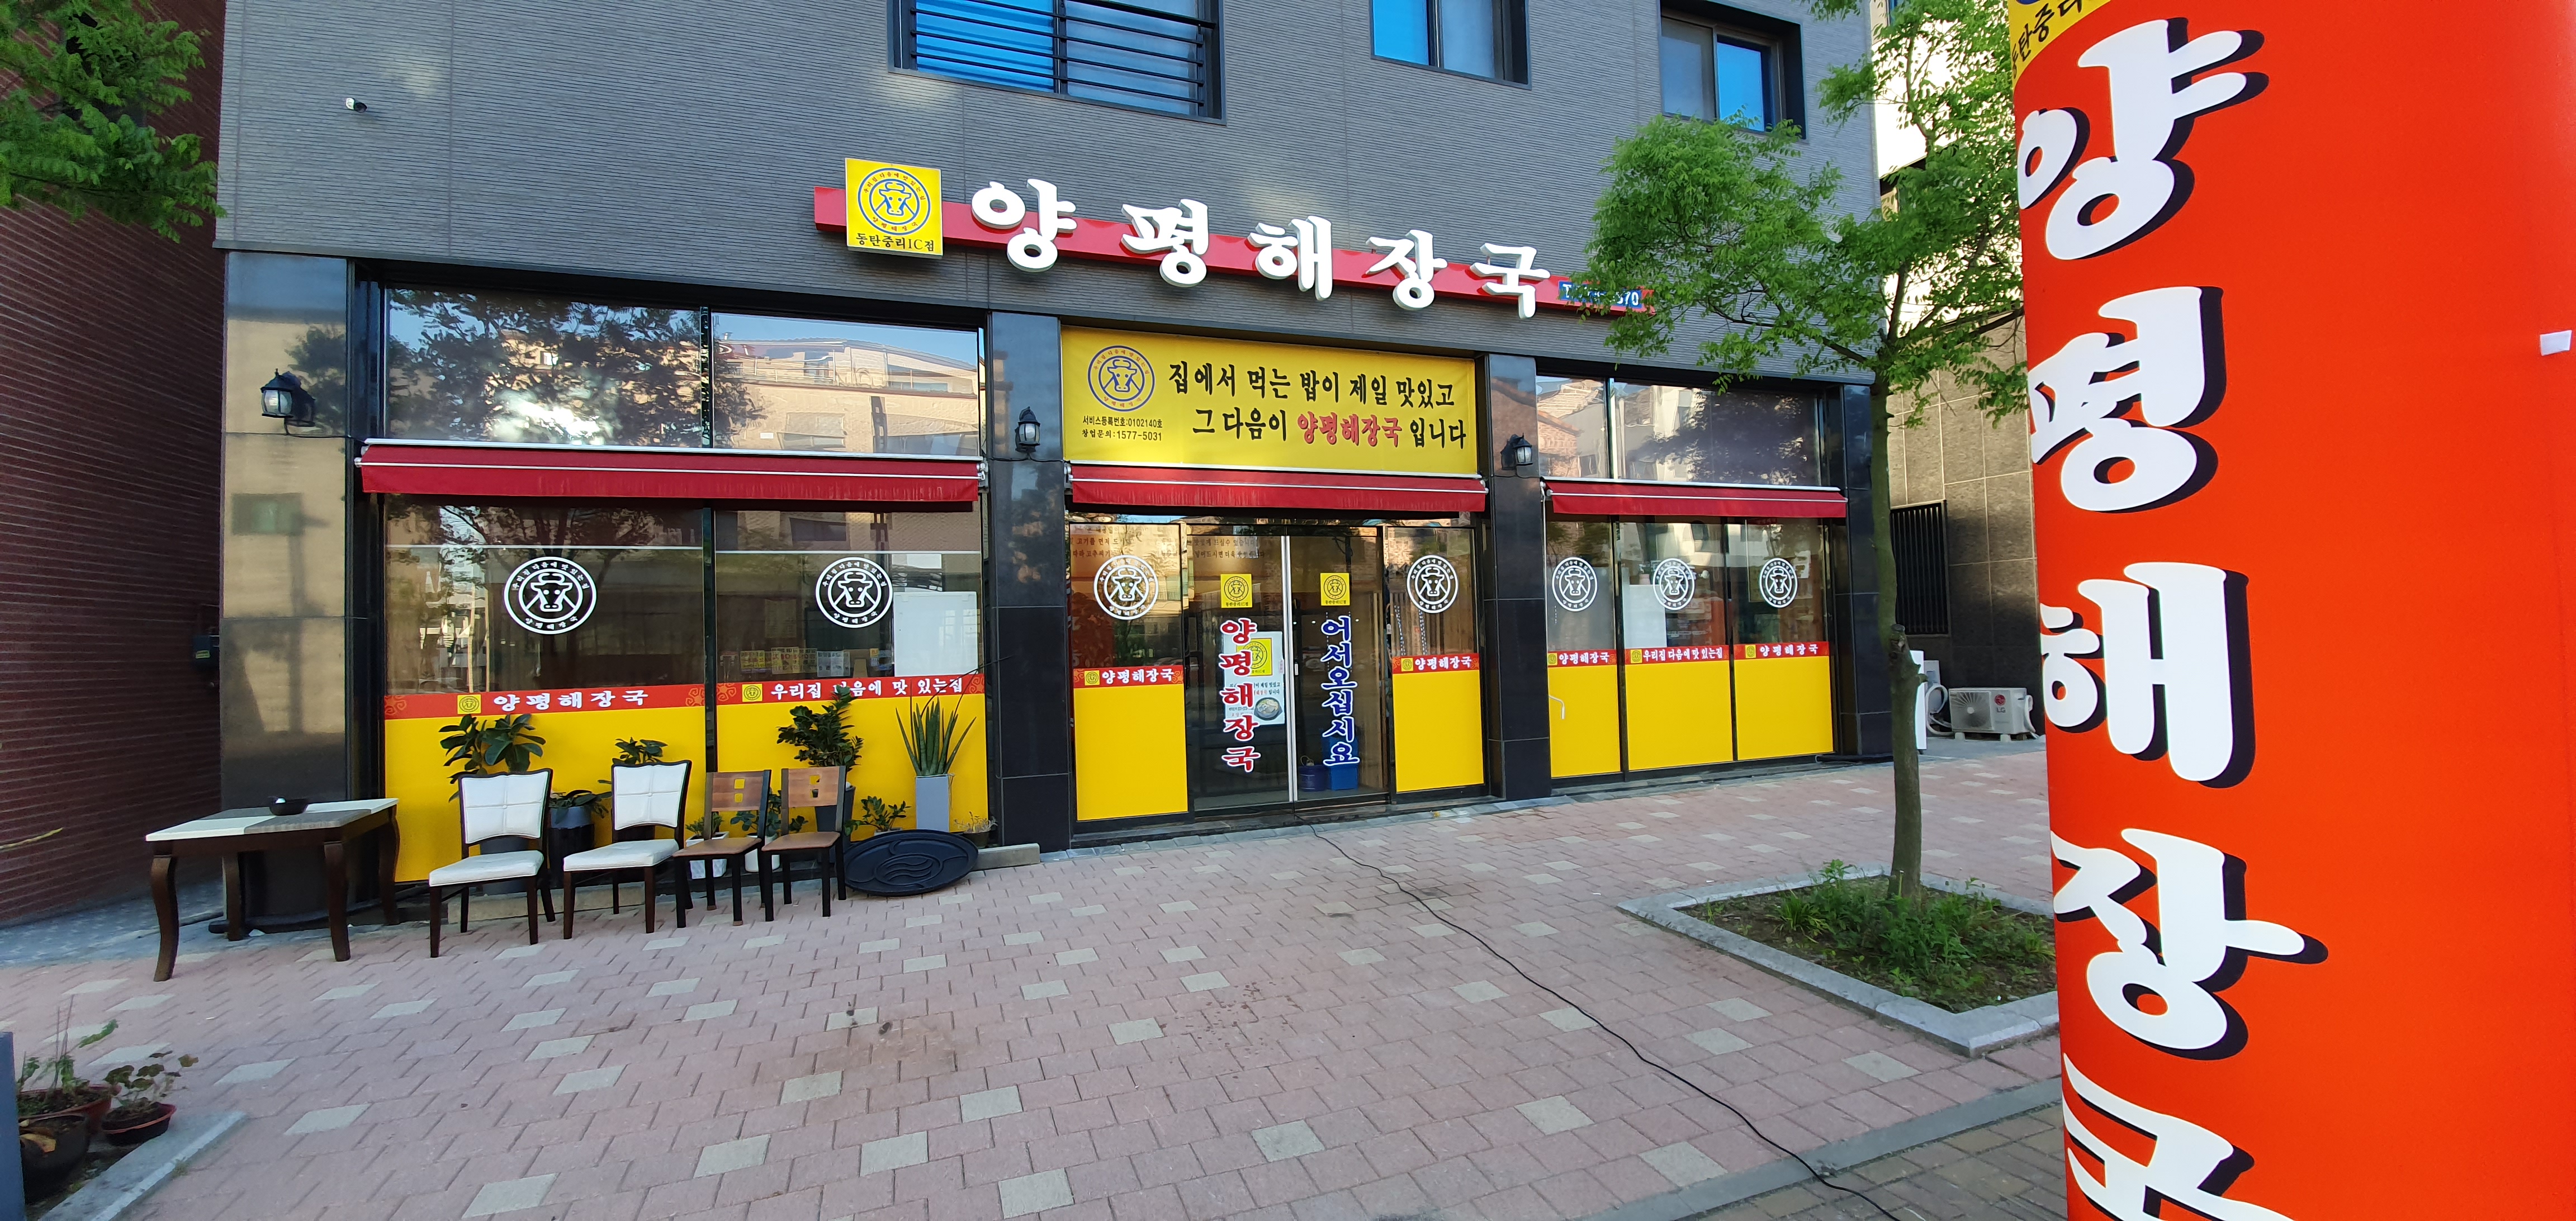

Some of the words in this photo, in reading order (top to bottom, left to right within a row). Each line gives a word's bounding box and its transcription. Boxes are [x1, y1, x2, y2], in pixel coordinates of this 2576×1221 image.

[856, 233, 934, 252] 동탄중리IC점
[971, 178, 1551, 320] 양평해장국
[1169, 361, 1235, 397] 집에서
[1247, 366, 1291, 399] 먹는
[1300, 370, 1338, 403] 밥이
[1349, 373, 1387, 405] 제일
[1396, 377, 1455, 409] 맛있고
[1083, 415, 1163, 428] 서비스등록번호:0102140호
[1193, 409, 1215, 433] 그
[1223, 407, 1286, 441] 다음이
[1298, 411, 1402, 448] 양평해장국
[1410, 418, 1466, 449] 입니다
[1559, 651, 1609, 665] 양평해장국
[1643, 649, 1666, 662] 우리집
[1668, 649, 1690, 660] 다음에
[1760, 643, 1818, 657] 양평해장국
[1415, 656, 1472, 670] 양평해장국
[1102, 668, 1174, 684] 양평해장국
[771, 682, 821, 699] 우리집
[892, 679, 908, 695] 맛
[918, 677, 963, 694] 있는집
[1219, 618, 1260, 772] 양평해장국
[1320, 616, 1360, 766] 어서오십시요
[494, 690, 648, 711] 양평해장국
